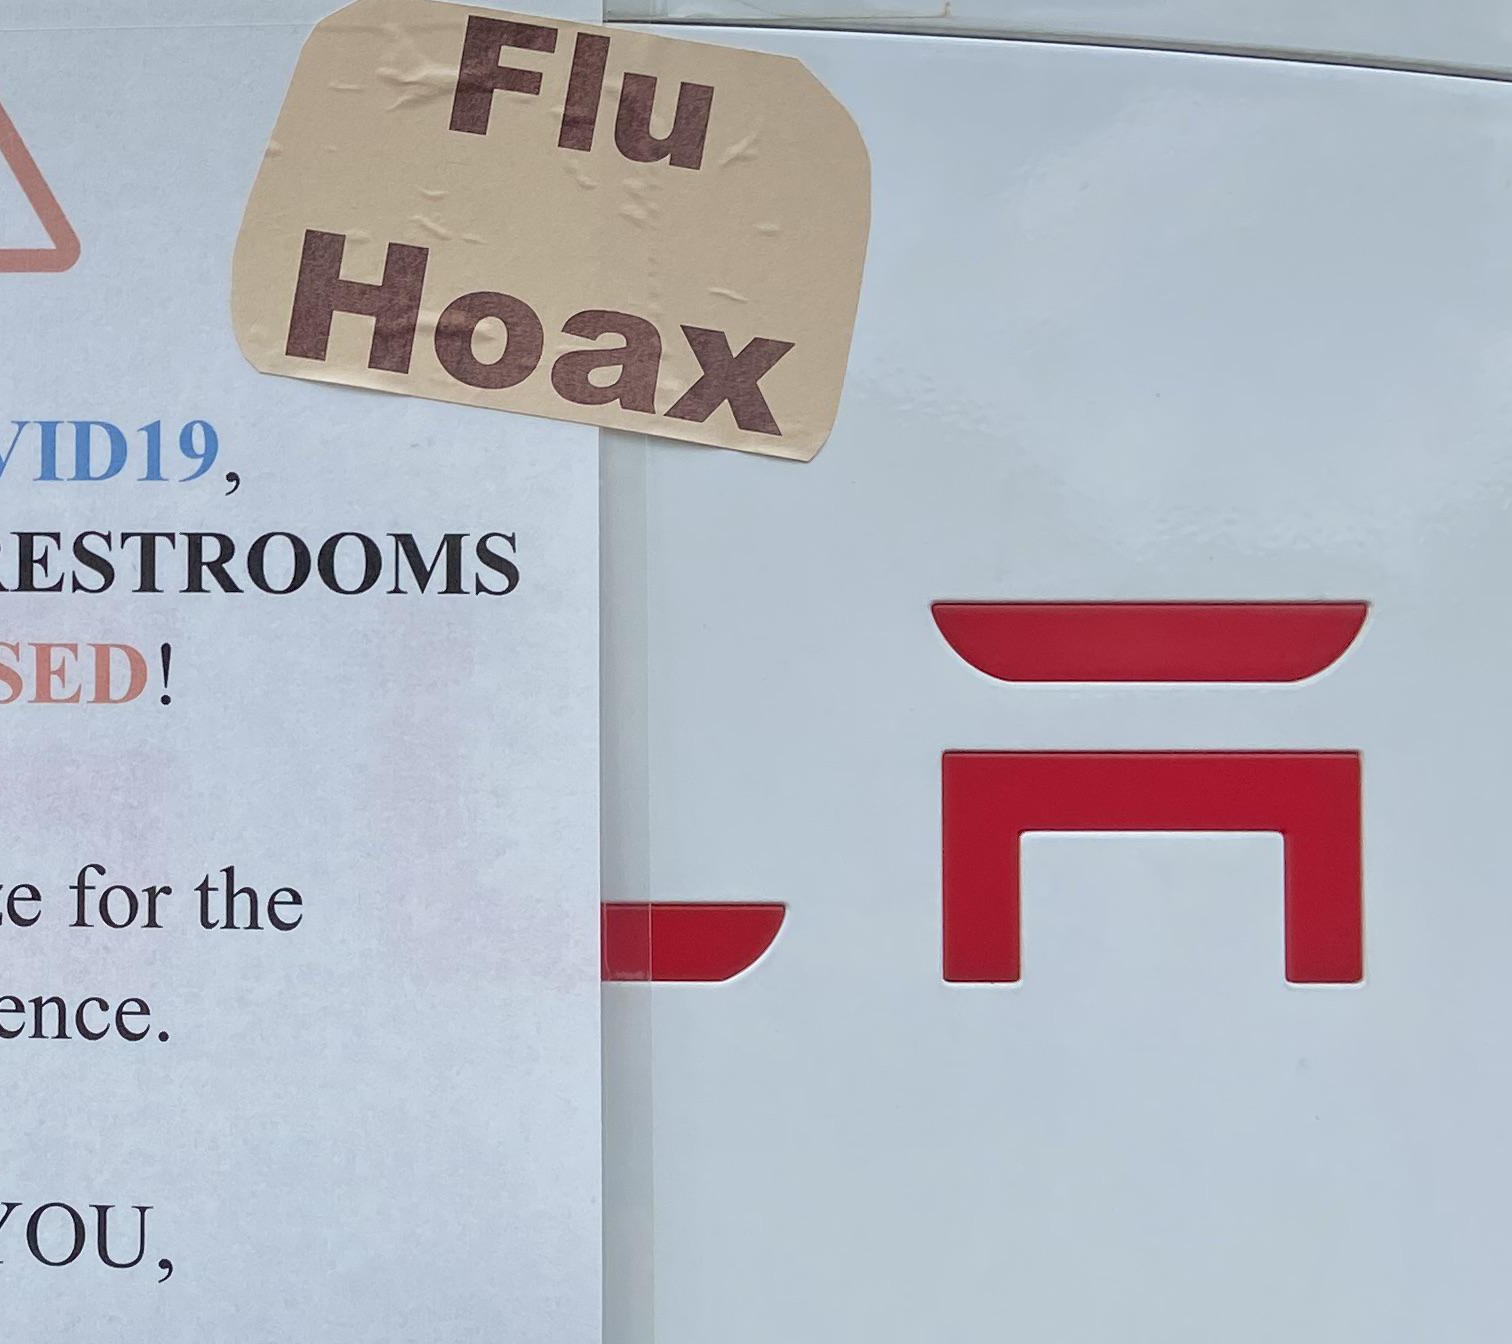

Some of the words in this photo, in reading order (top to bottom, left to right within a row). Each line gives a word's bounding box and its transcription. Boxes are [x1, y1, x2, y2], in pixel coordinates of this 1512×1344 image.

[447, 14, 715, 171] Flu
[284, 228, 796, 437] Hoax
[68, 863, 175, 929] for
[193, 865, 304, 932] the
